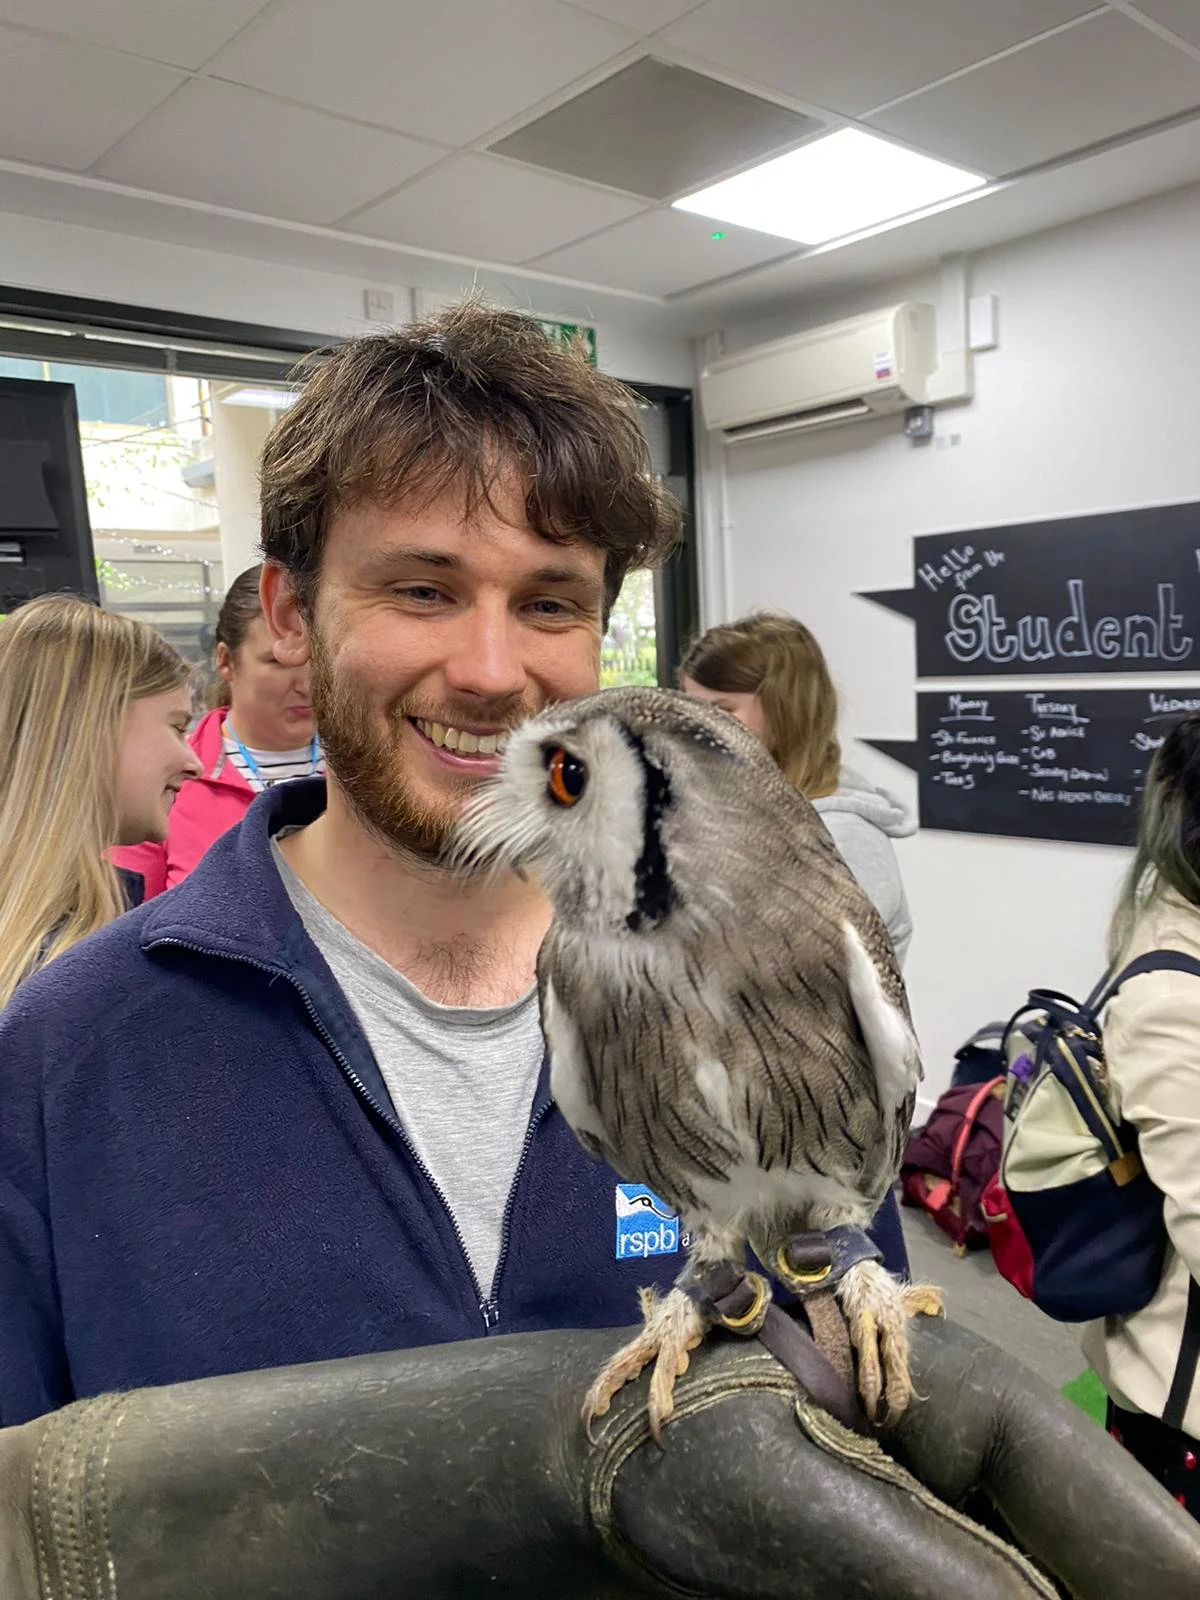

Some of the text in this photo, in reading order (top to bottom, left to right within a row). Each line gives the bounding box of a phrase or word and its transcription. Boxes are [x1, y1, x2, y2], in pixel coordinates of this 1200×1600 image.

[917, 545, 974, 592] Hello
[944, 579, 1193, 662] Student
[620, 1223, 675, 1258] rspb
